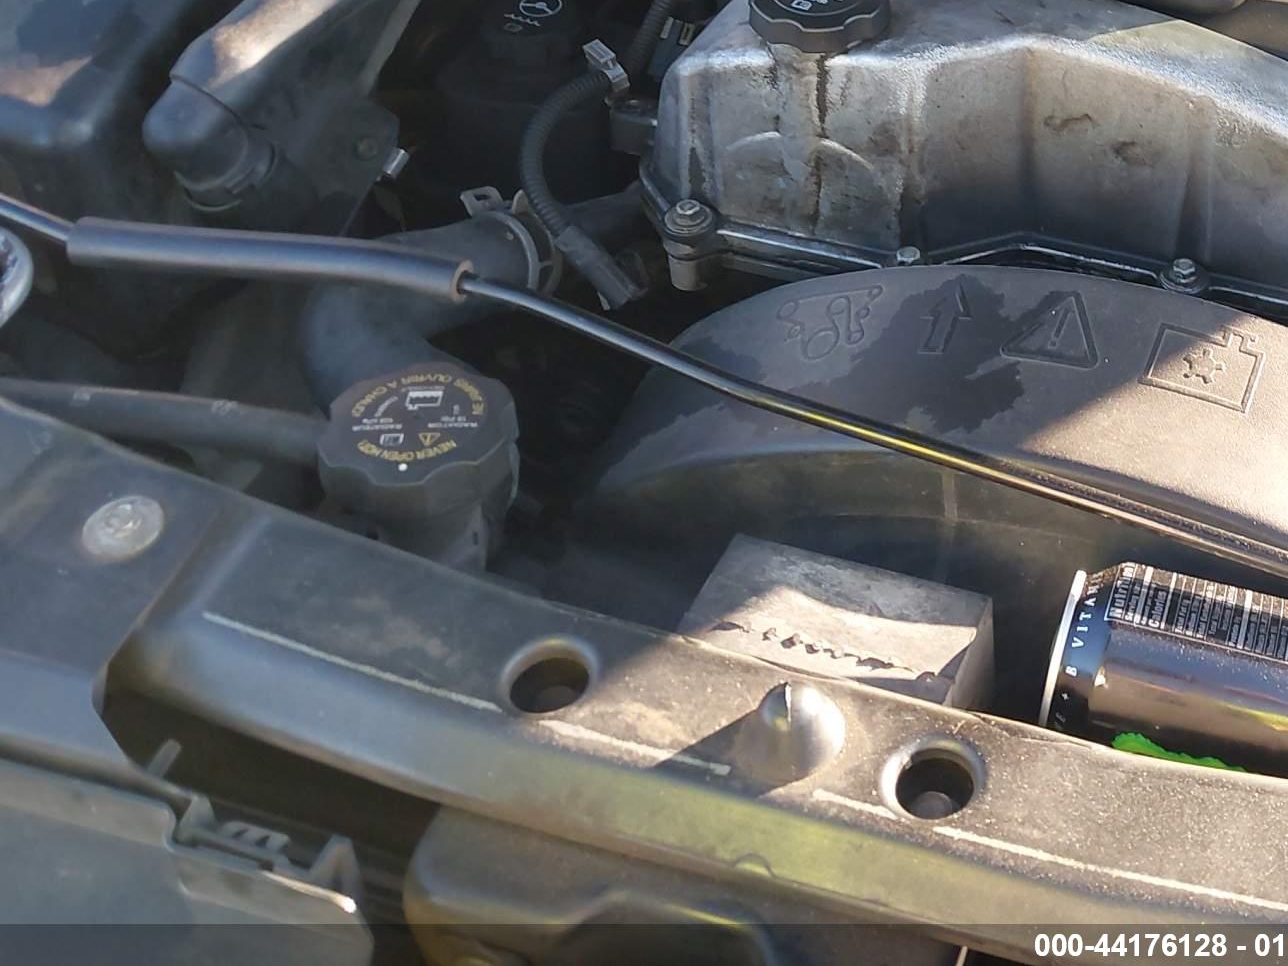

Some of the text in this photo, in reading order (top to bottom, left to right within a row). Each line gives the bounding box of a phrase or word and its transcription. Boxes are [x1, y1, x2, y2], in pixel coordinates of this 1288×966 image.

[381, 450, 415, 461] OPEN
[415, 439, 457, 460] NEVER
[1125, 594, 1139, 622] Serving
[1147, 589, 1168, 628] Calories
